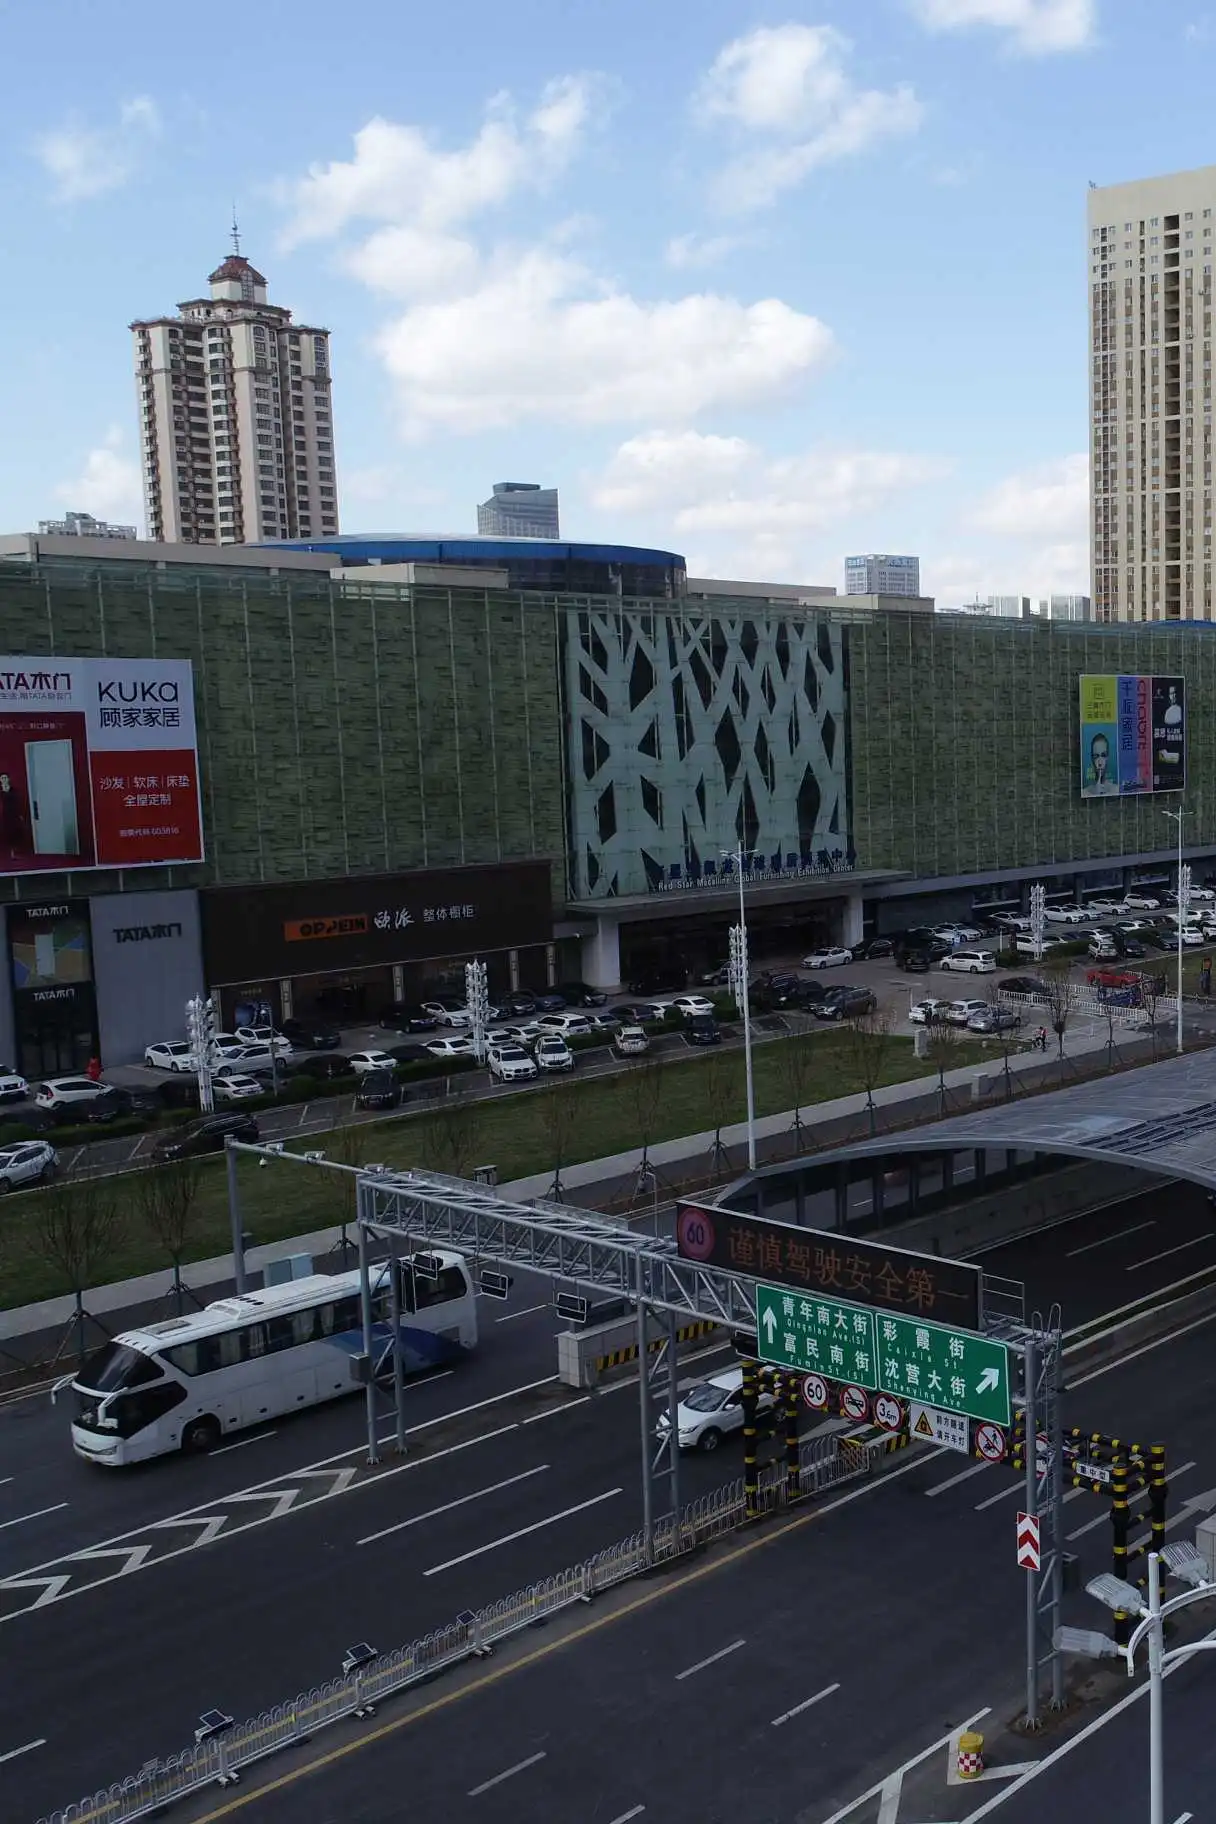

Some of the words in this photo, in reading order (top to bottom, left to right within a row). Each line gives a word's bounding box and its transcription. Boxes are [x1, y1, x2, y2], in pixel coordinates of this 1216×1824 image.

[0, 672, 71, 690] TA木门
[100, 707, 180, 728] 顾家家居
[123, 793, 172, 806] 全屋定制
[658, 881, 673, 891] Red
[677, 880, 693, 889] Star
[734, 871, 756, 883] Gobal
[26, 905, 70, 918] TATA木门
[423, 904, 474, 922] 整体橱柜
[112, 922, 182, 943] TATA木门
[33, 988, 75, 1001] TATA木门
[686, 1221, 704, 1245] 60
[728, 1226, 970, 1309] 谨慎驾驶安全第一
[782, 1296, 867, 1335] 青年南大街
[787, 1318, 827, 1336] Qingnian
[883, 1320, 965, 1360] 彩霞街
[783, 1332, 869, 1372] 富民南街
[885, 1357, 967, 1399] 沈营大街
[806, 1381, 823, 1401] 60
[887, 1379, 935, 1403] Shenying
[879, 1402, 897, 1422] 3.6m
[936, 1414, 965, 1432] 前方隧道
